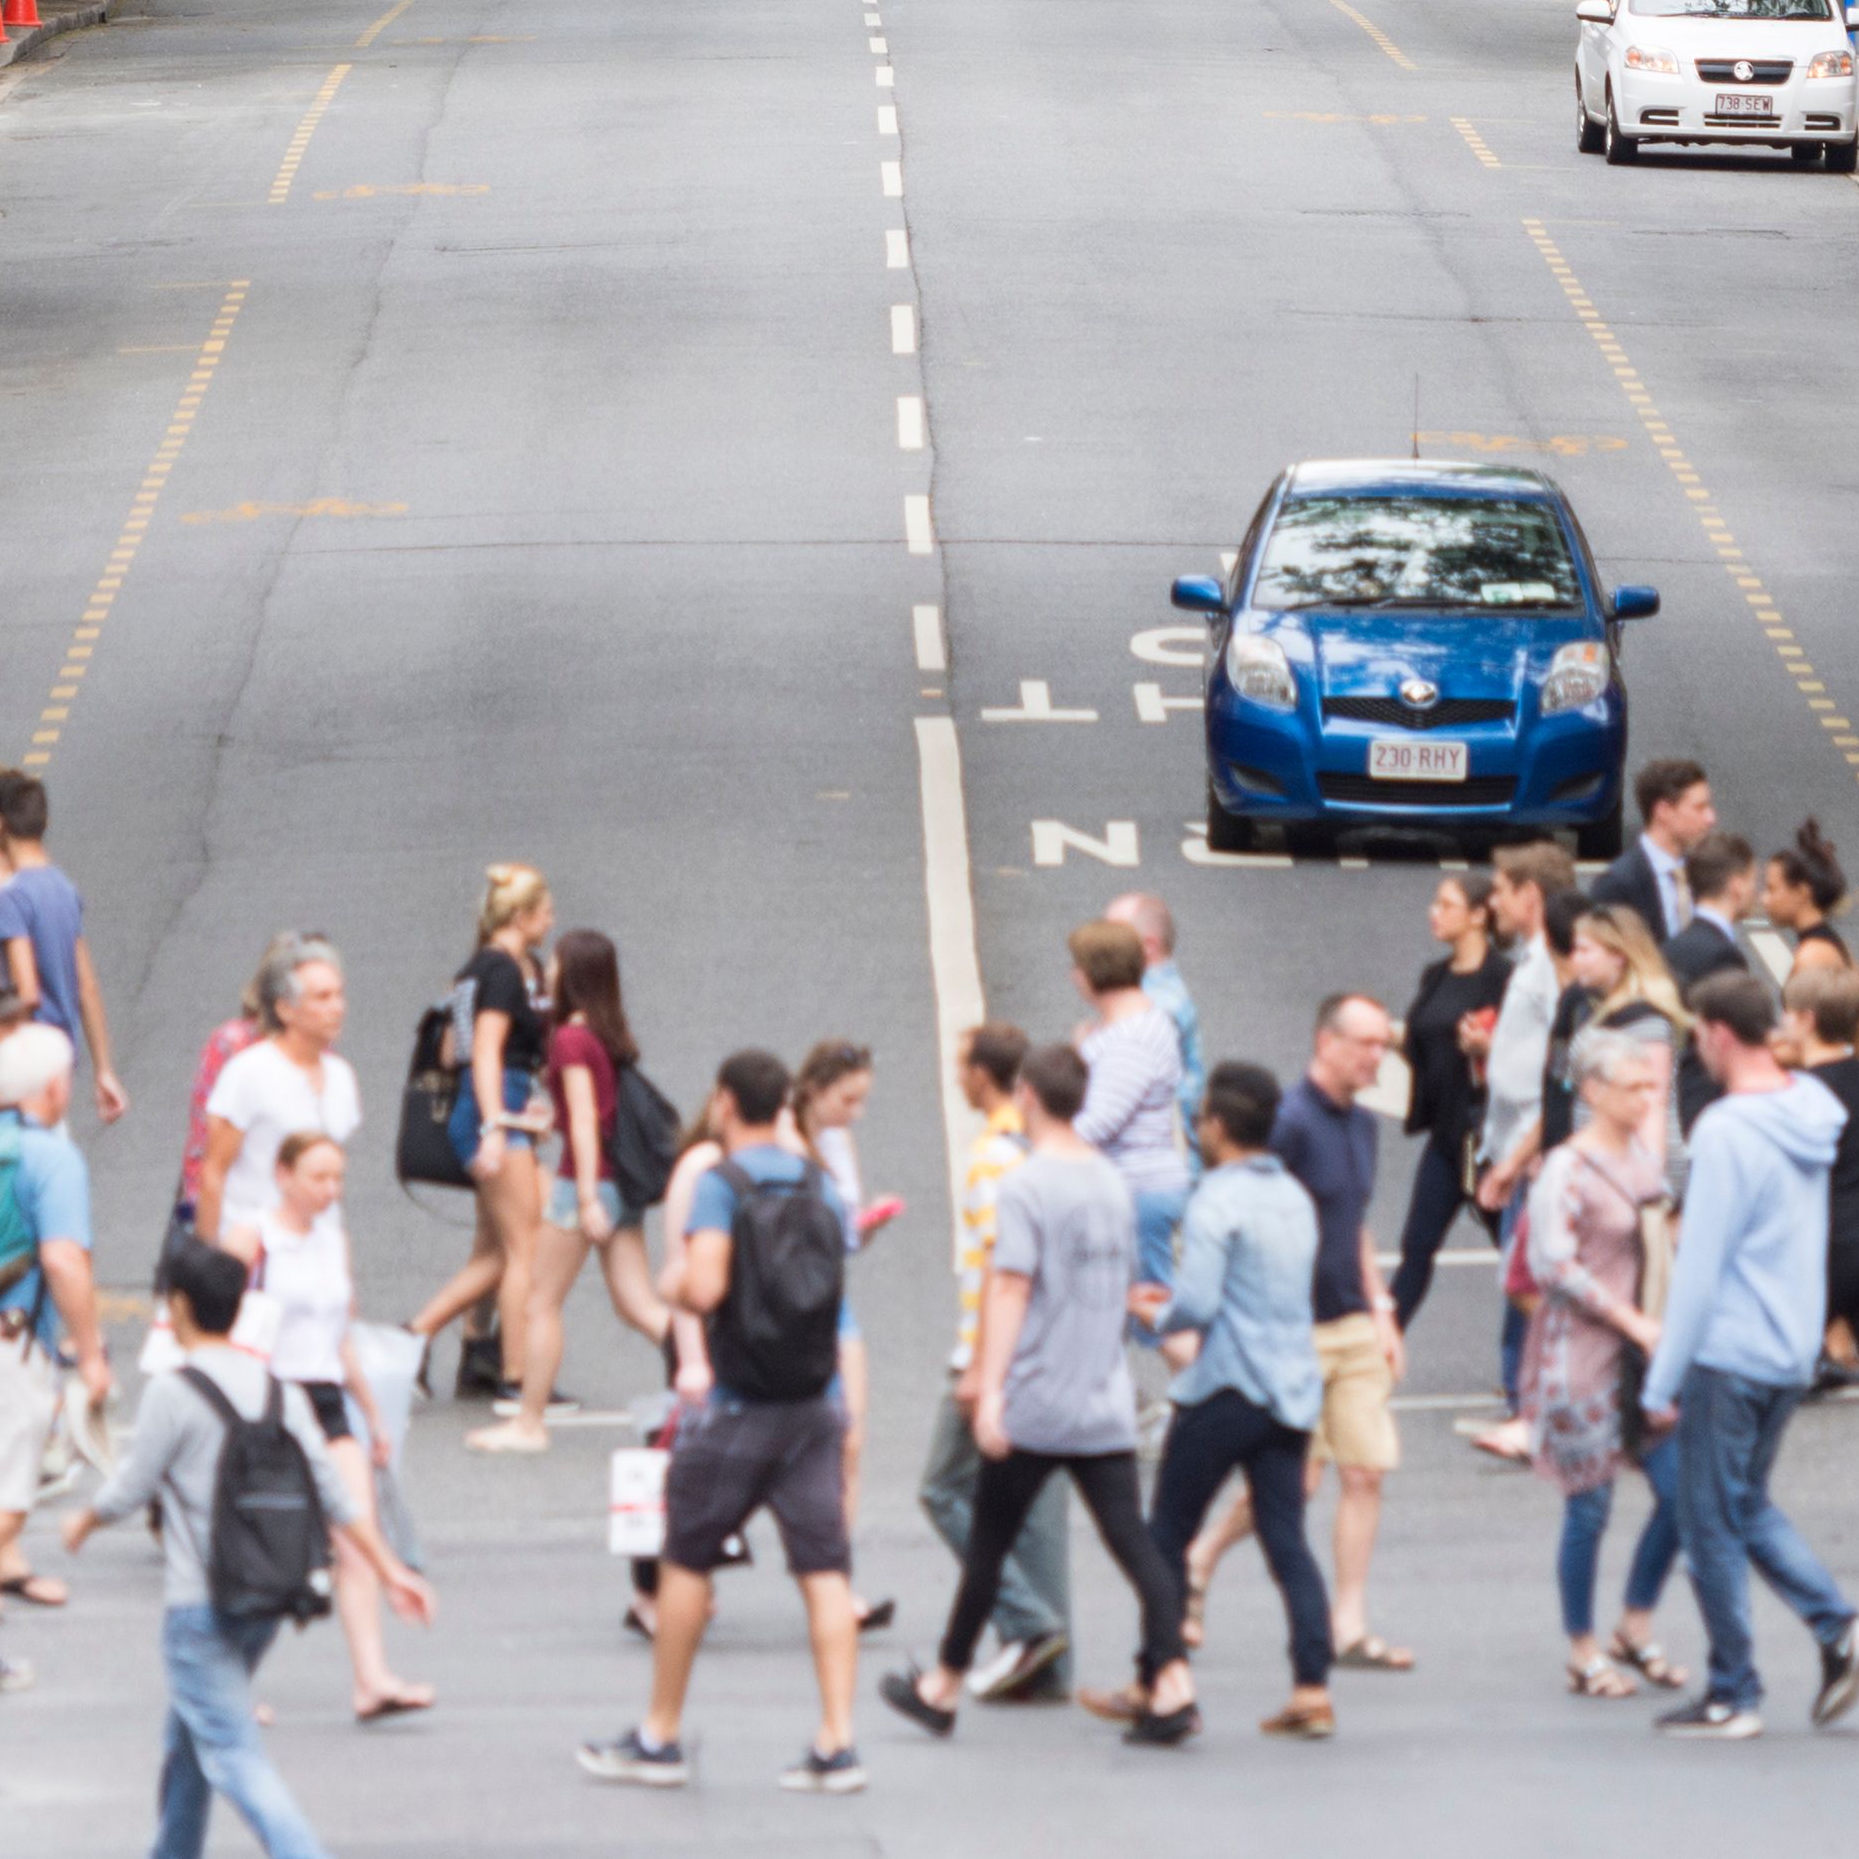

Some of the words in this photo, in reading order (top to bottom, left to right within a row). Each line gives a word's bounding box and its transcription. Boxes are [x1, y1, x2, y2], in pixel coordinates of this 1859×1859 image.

[1718, 95, 1741, 111] 738
[1745, 97, 1771, 111] SEW
[1375, 745, 1413, 769] 230
[1418, 747, 1461, 771] RHY
